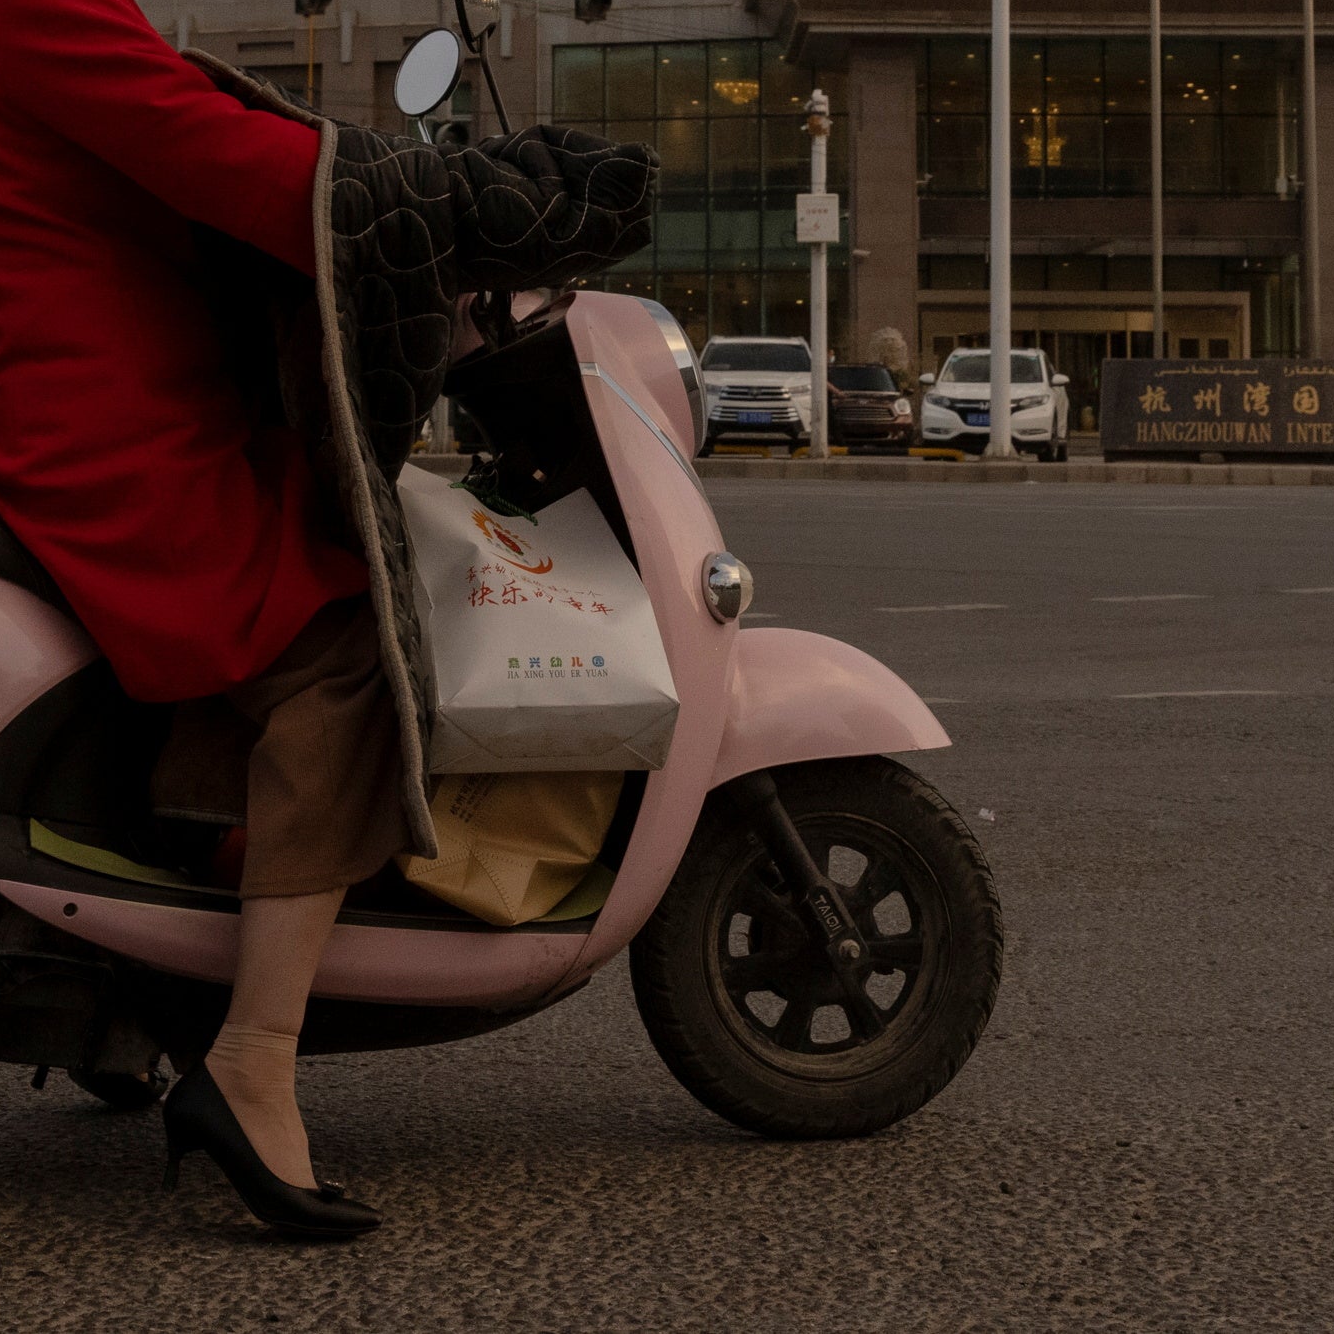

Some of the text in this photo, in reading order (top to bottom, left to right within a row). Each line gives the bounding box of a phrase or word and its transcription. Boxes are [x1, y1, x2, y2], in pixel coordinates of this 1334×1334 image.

[1136, 421, 1271, 444] HANGZHOUWAN
[524, 670, 544, 679] XING
[549, 670, 566, 678] YOU
[571, 669, 581, 678] ER
[585, 669, 608, 678] YUAN
[814, 894, 843, 931] TAIQI
